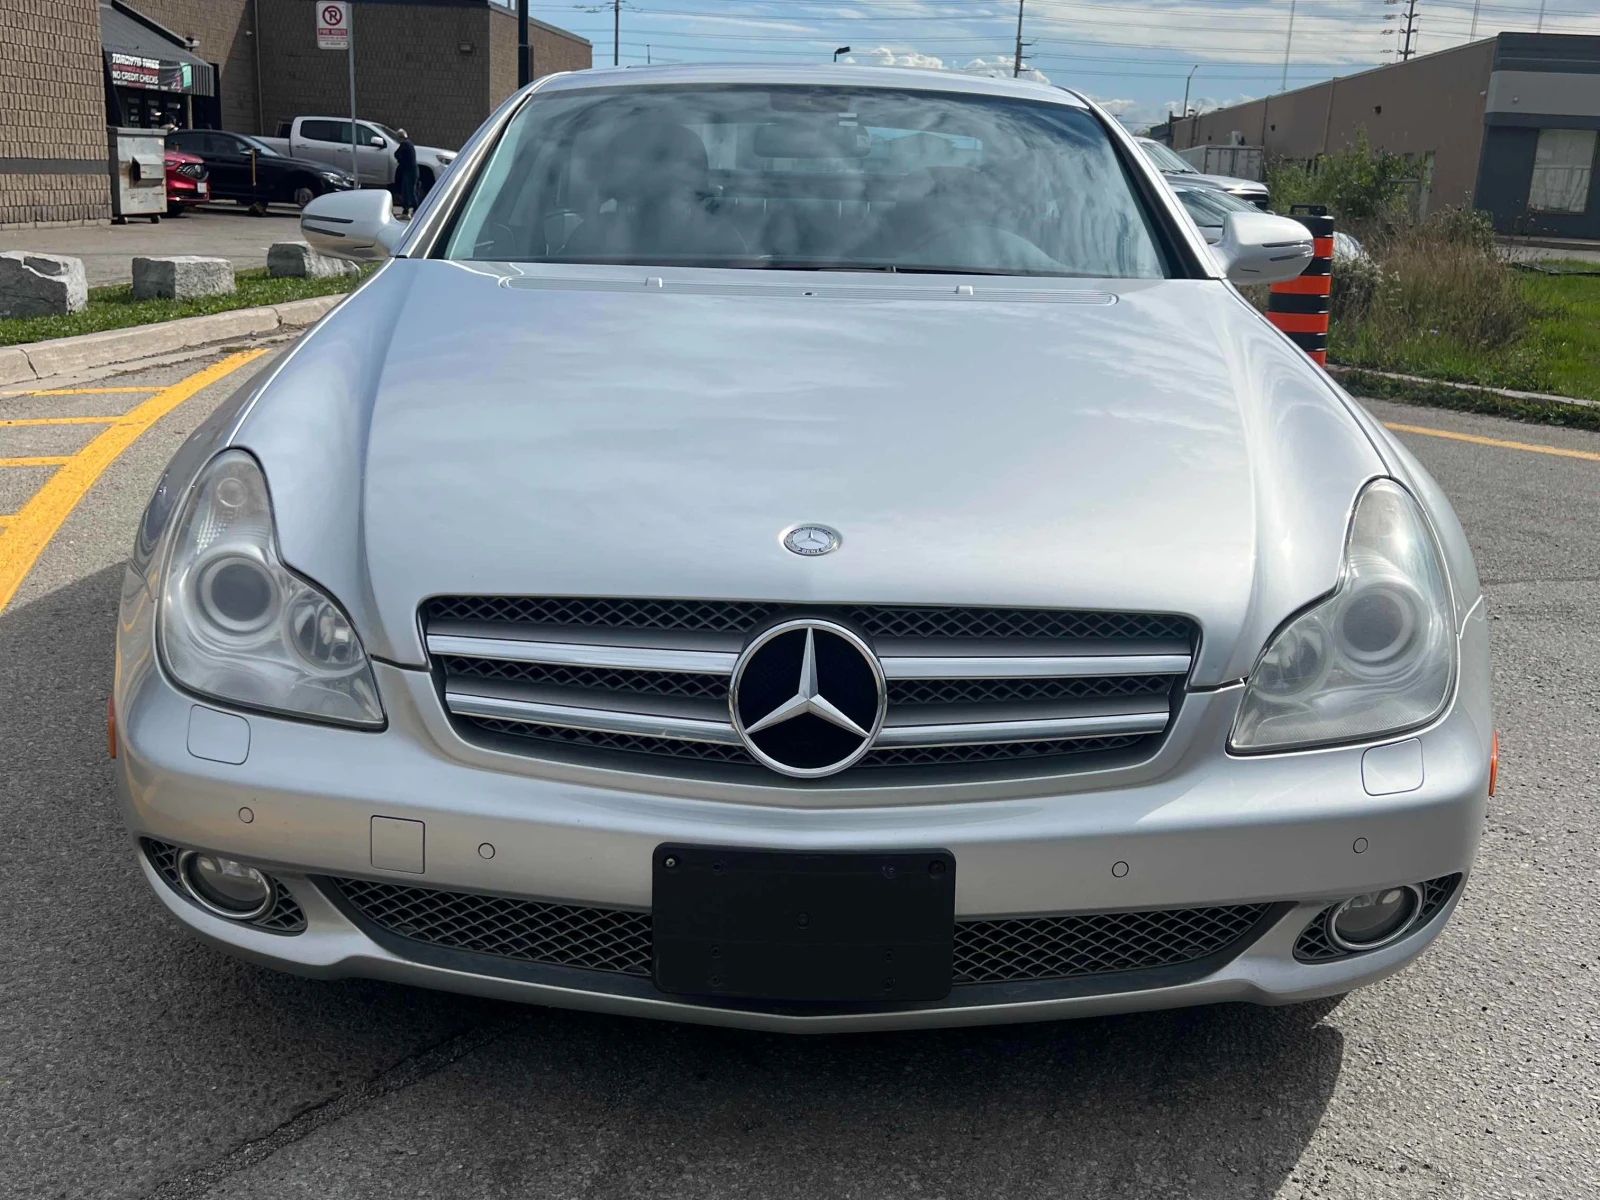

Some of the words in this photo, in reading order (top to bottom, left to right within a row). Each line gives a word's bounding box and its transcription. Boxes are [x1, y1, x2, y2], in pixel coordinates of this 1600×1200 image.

[112, 70, 121, 79] NO
[121, 72, 139, 82] CREDIT
[140, 74, 159, 84] CHECKS
